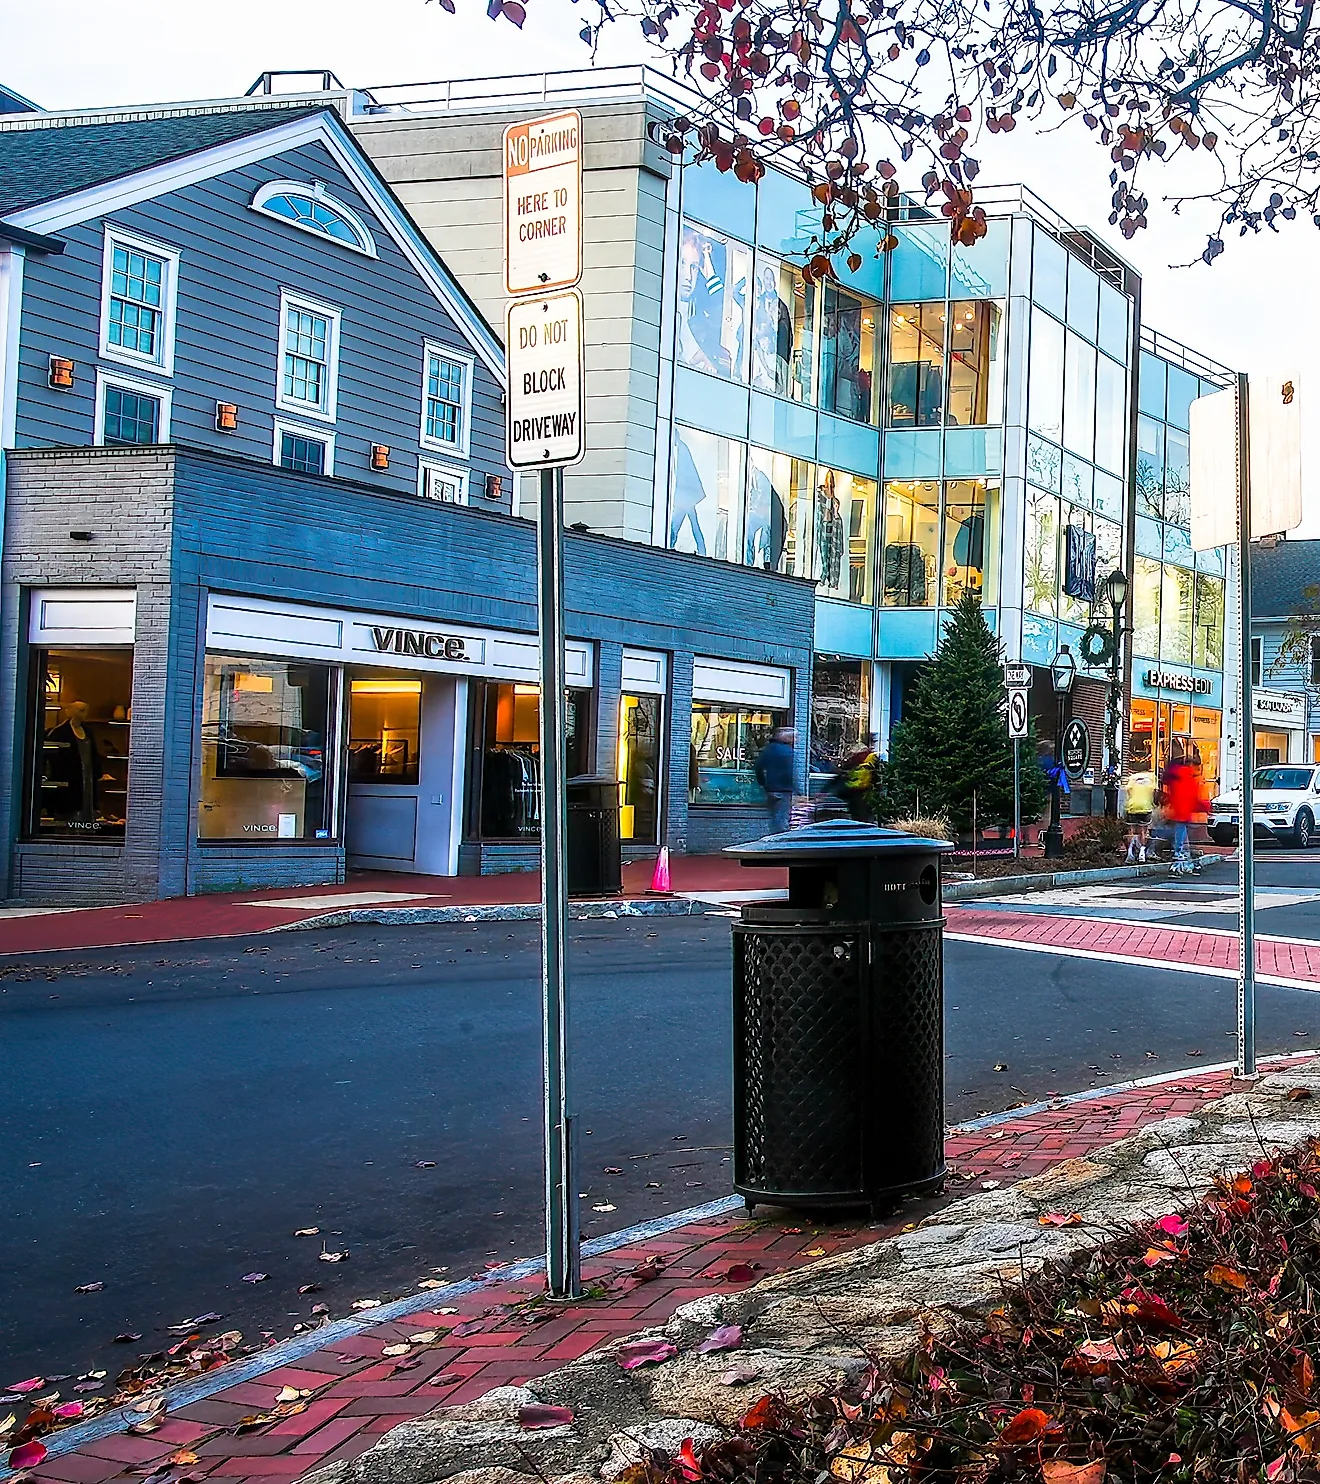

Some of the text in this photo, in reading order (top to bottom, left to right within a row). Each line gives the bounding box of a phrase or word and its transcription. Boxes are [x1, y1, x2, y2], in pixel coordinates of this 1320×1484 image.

[508, 128, 577, 168] NO PARKING
[517, 187, 567, 215] HERE TO
[519, 216, 567, 242] CORNER
[519, 319, 568, 349] DO NOT
[523, 367, 566, 395] BLOCK
[513, 412, 577, 443] DRIVEWAY
[1150, 669, 1214, 694] EXPRESS EDIT
[716, 746, 746, 760] SALE
